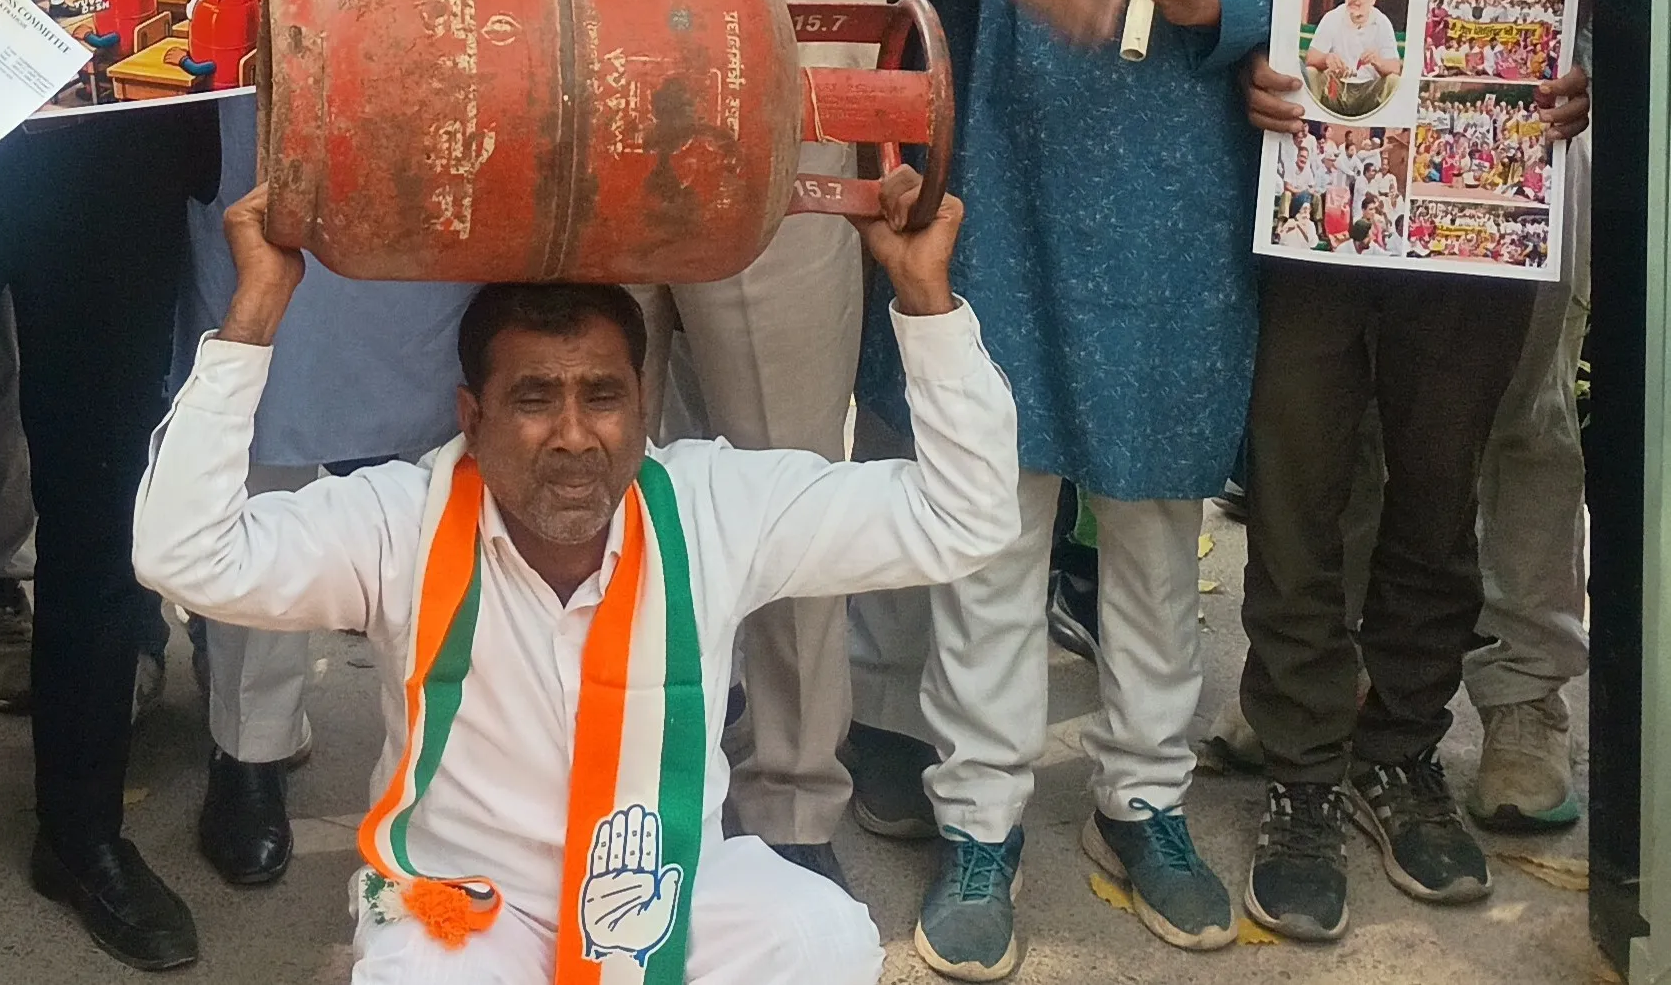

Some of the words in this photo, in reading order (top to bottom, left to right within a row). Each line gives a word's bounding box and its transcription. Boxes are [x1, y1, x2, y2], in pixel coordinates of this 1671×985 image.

[17, 6, 72, 54] COMMITTEE
[794, 15, 848, 31] 15.7
[793, 180, 842, 199] 15.7
